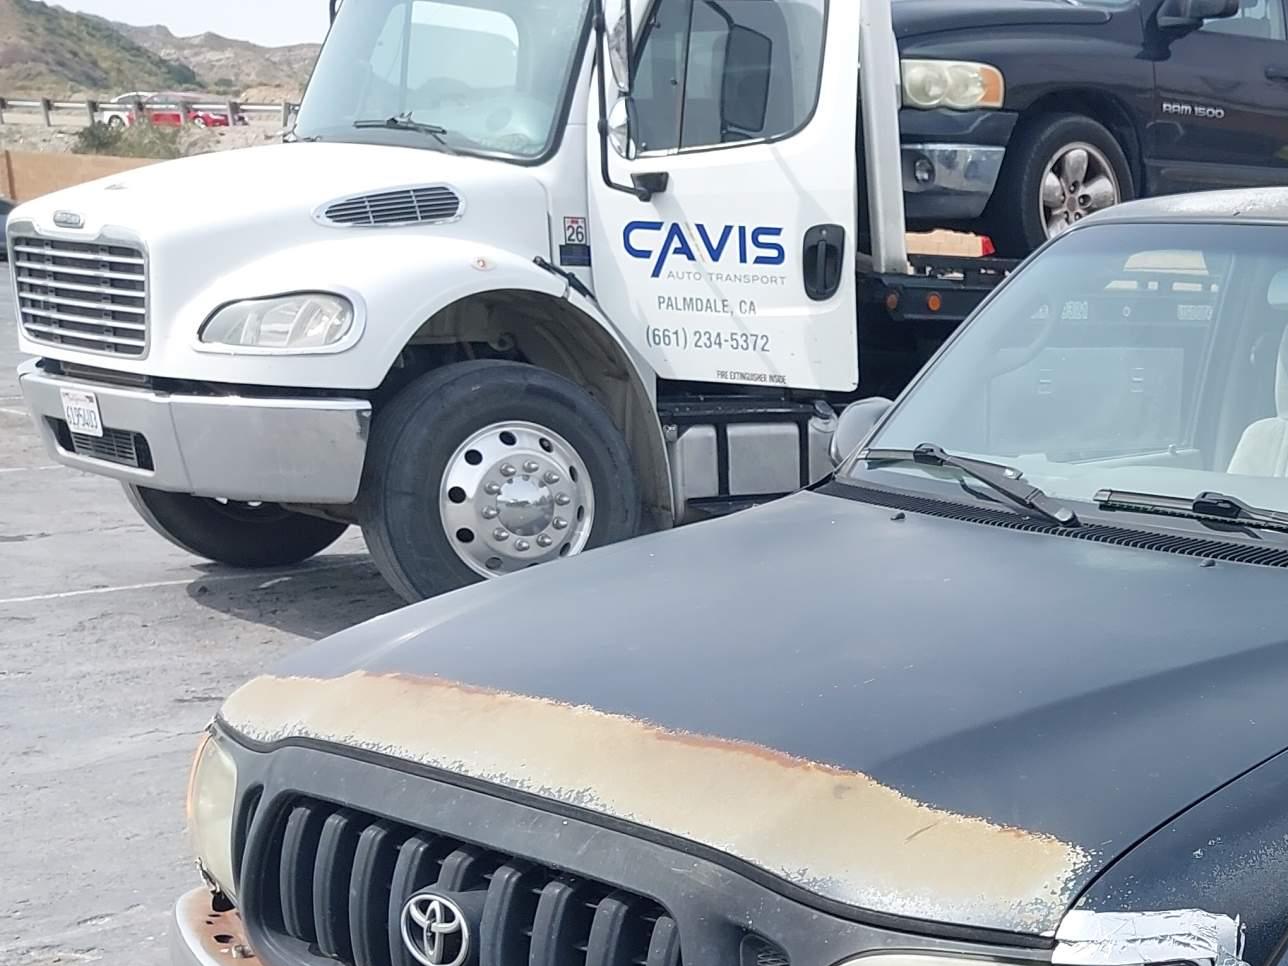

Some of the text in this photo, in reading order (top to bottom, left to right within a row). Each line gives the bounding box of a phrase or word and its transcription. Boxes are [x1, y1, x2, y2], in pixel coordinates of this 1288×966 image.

[1162, 103, 1225, 119] RAM 1500
[567, 224, 585, 243] 26
[622, 220, 785, 278] CAVIS
[667, 270, 787, 286] AUTO TRANSPORT
[657, 295, 757, 316] PALMDALE, CA
[646, 325, 770, 352] (661) 234-5372
